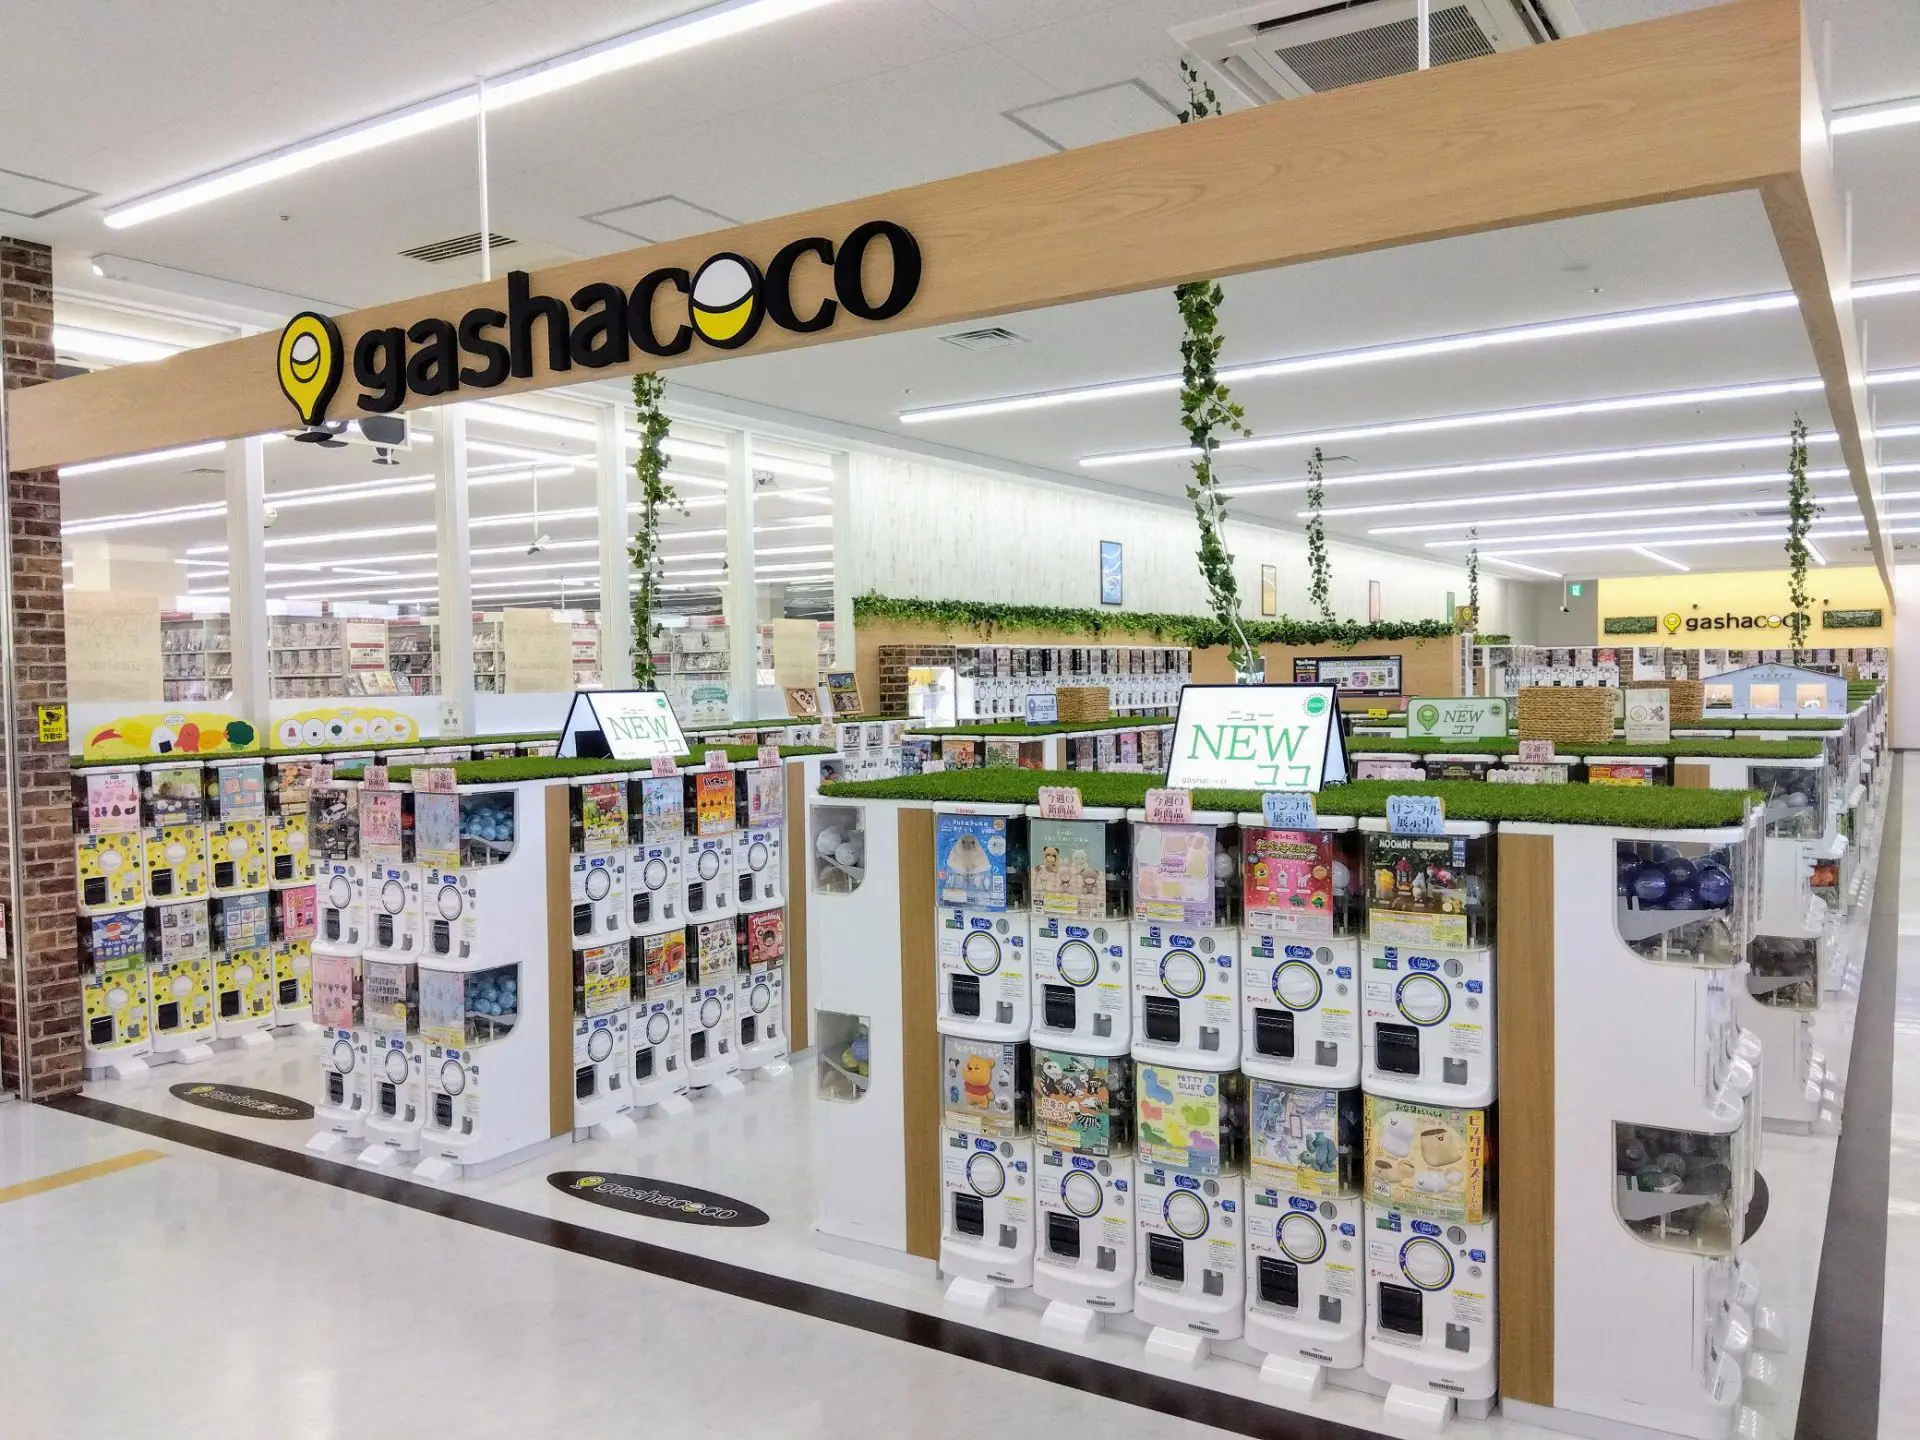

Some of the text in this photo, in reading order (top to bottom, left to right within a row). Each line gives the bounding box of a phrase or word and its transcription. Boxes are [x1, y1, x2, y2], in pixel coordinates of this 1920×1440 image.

[353, 219, 922, 413] gashacoco
[1227, 710, 1274, 721] ニュー
[1443, 710, 1484, 722] NEW
[606, 715, 669, 740] NEW
[1451, 725, 1475, 735] ココ
[654, 740, 684, 753] ココ
[1186, 724, 1310, 762] NEW
[1253, 764, 1311, 787] ココ
[1047, 794, 1074, 803] 今週の
[1154, 795, 1184, 806] 今週の
[1048, 804, 1076, 815] 新商品
[1153, 807, 1184, 819] 新商品
[1274, 811, 1307, 823] 展示中
[1397, 816, 1434, 828] 展示中
[1379, 839, 1411, 849] MOOMIN
[1177, 1074, 1203, 1083] PETTY
[1178, 1082, 1201, 1091] DUST
[593, 1182, 738, 1220] gashacoco
